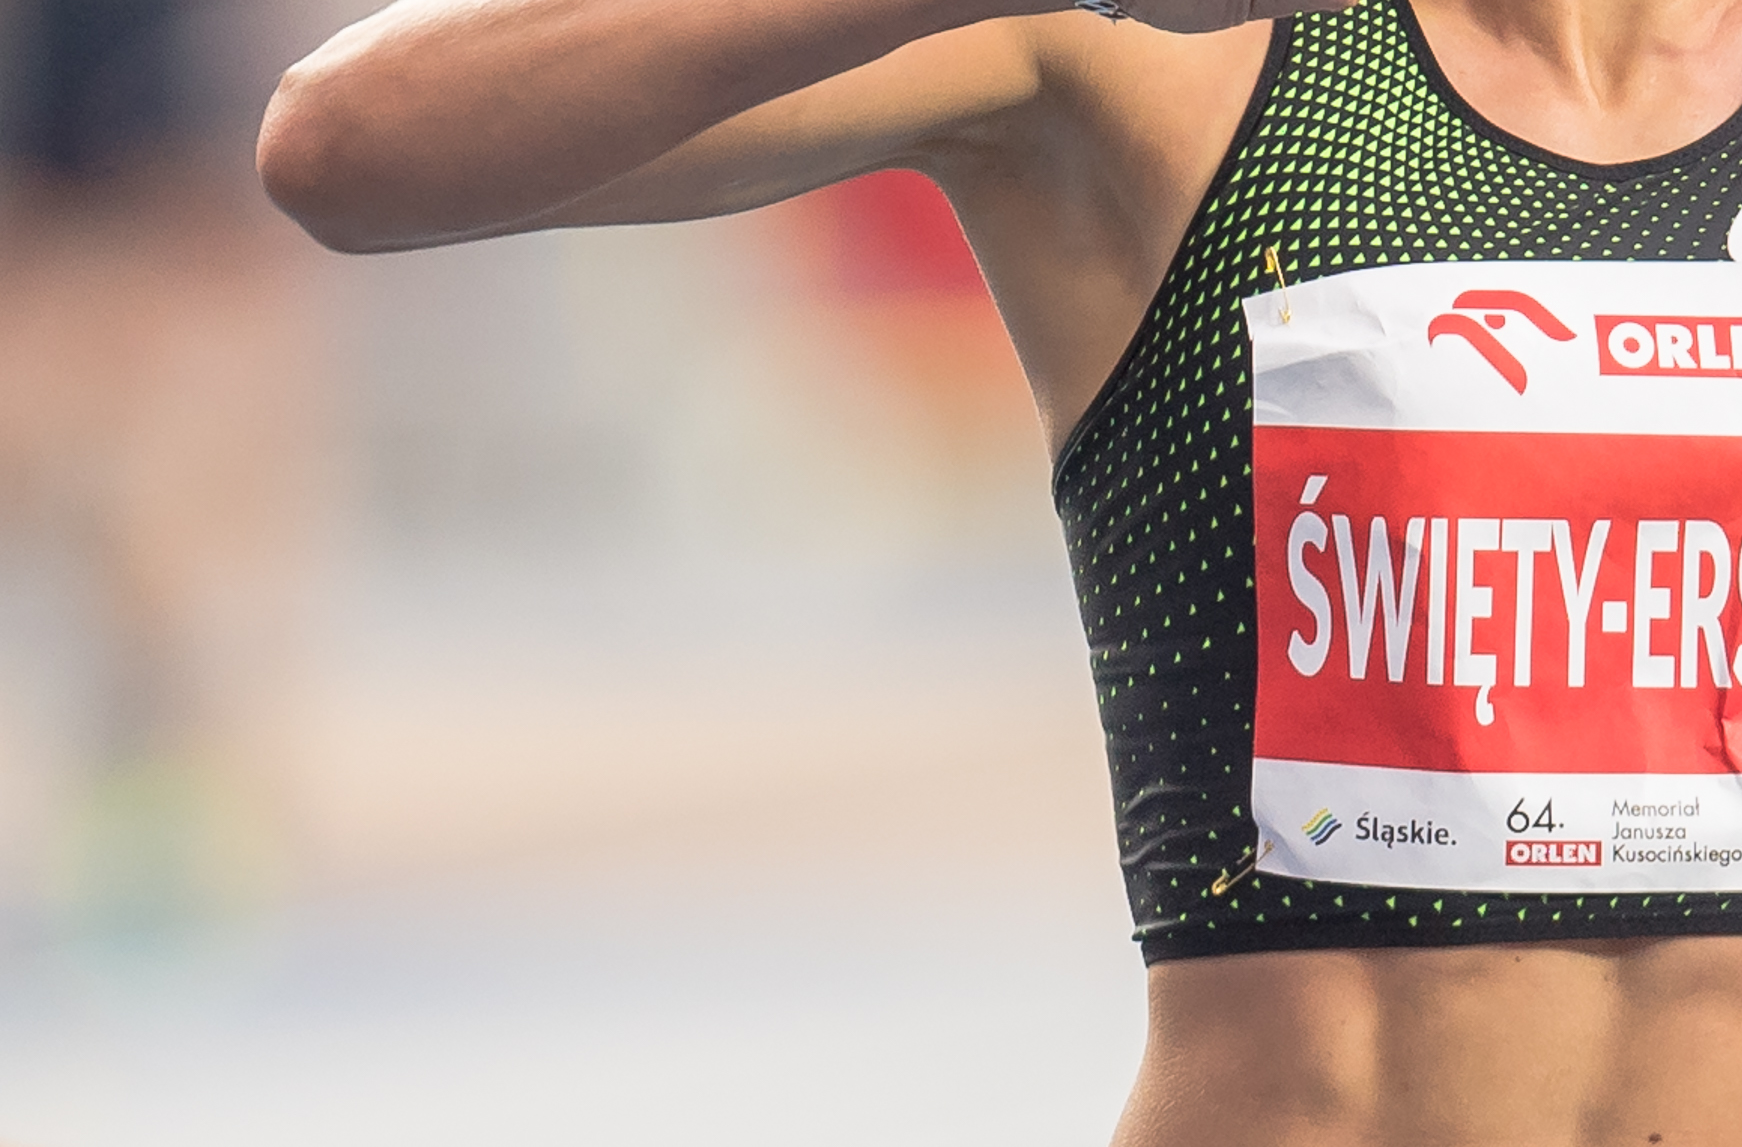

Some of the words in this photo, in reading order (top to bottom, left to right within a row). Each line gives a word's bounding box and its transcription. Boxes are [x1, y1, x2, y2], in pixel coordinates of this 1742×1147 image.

[1506, 797, 1565, 834] 64.
[1611, 797, 1700, 818] Memoriał
[1355, 810, 1458, 849] Śląskie.
[1611, 821, 1687, 841] Janusza
[1510, 843, 1597, 864] ORLEN
[1612, 842, 1742, 868] Kusocińskiego
